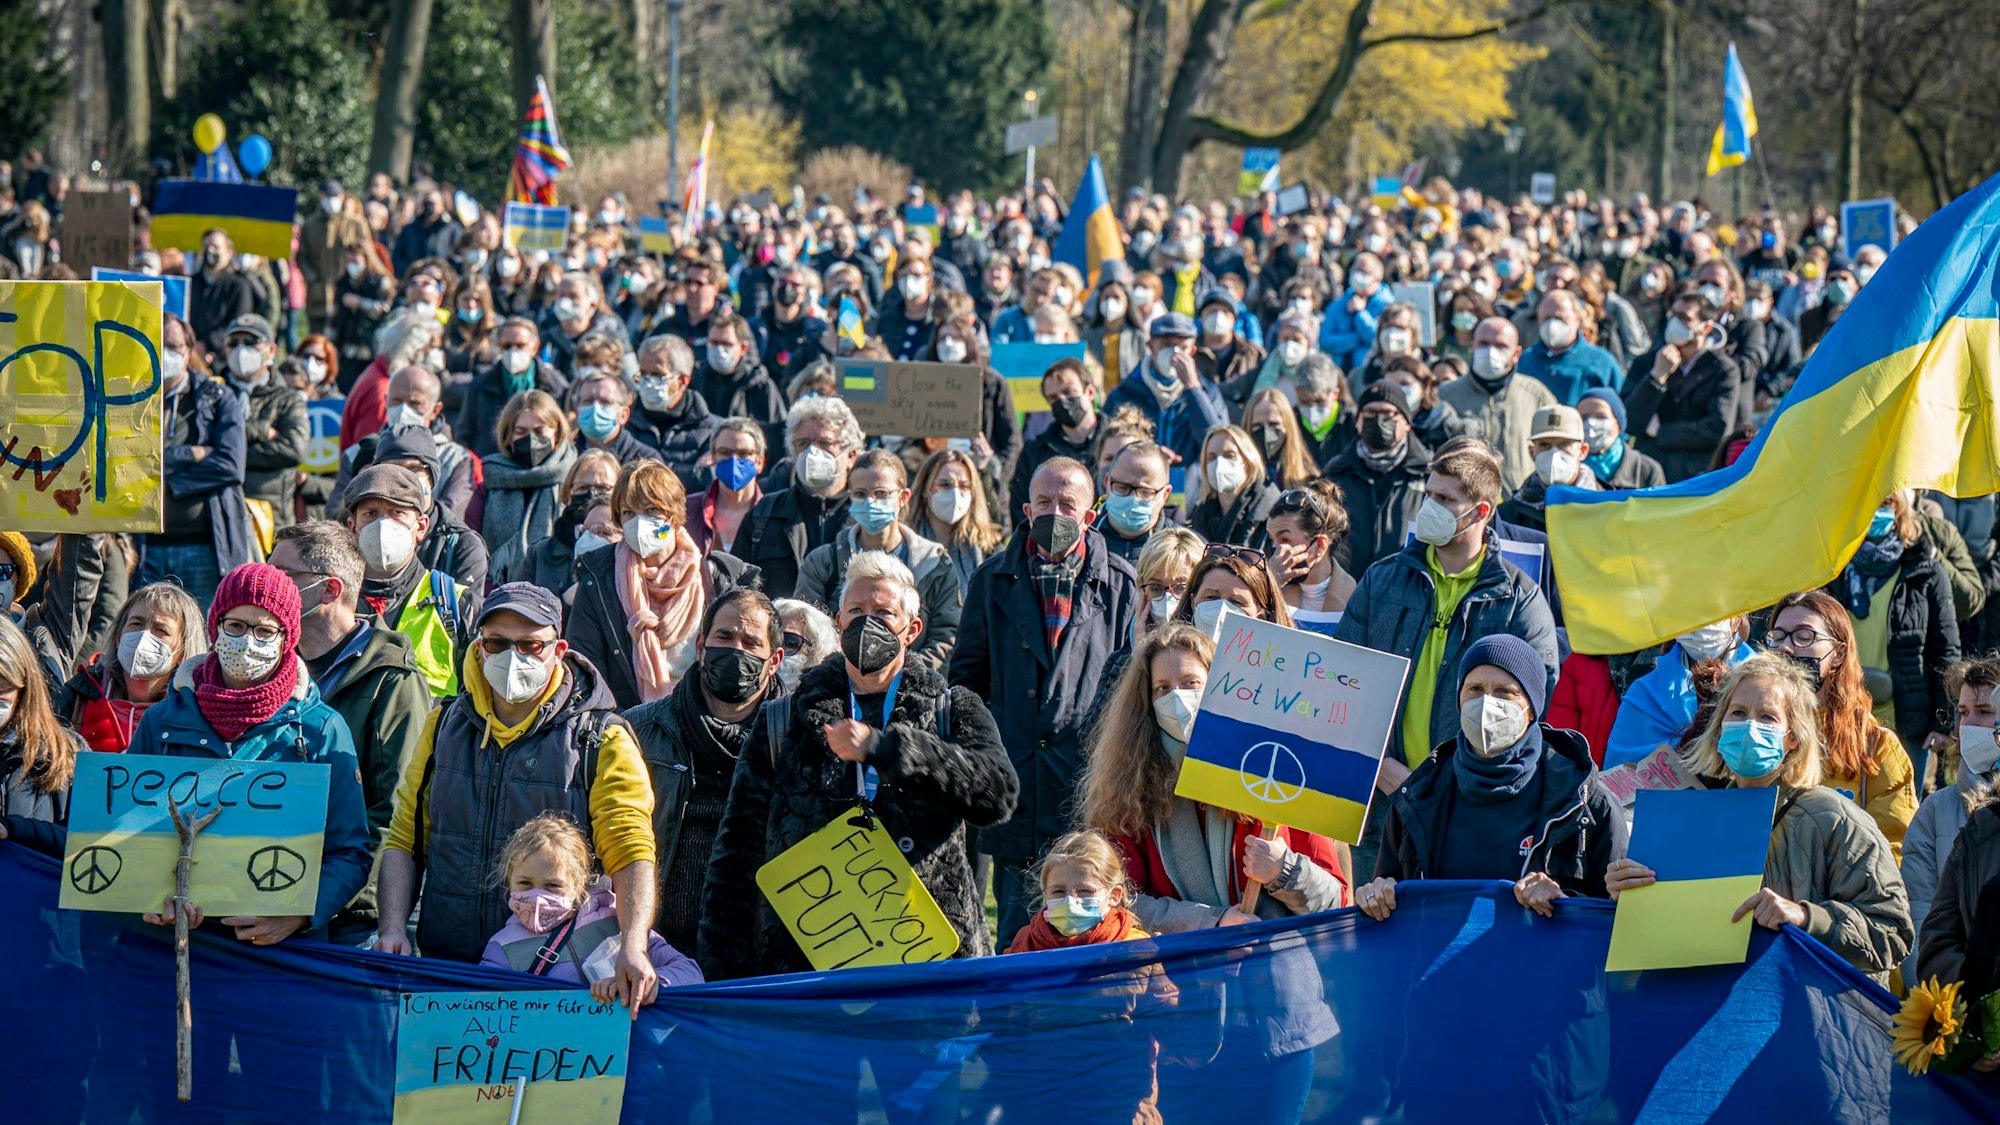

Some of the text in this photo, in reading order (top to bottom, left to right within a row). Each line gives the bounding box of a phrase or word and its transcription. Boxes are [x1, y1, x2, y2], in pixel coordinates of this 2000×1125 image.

[0, 312, 161, 503] OP
[1303, 651, 1361, 690] Peace
[1210, 671, 1264, 705] Not
[1274, 687, 1320, 721] War
[524, 999, 551, 1011] mir
[557, 998, 586, 1015] für
[588, 1002, 615, 1016] uns
